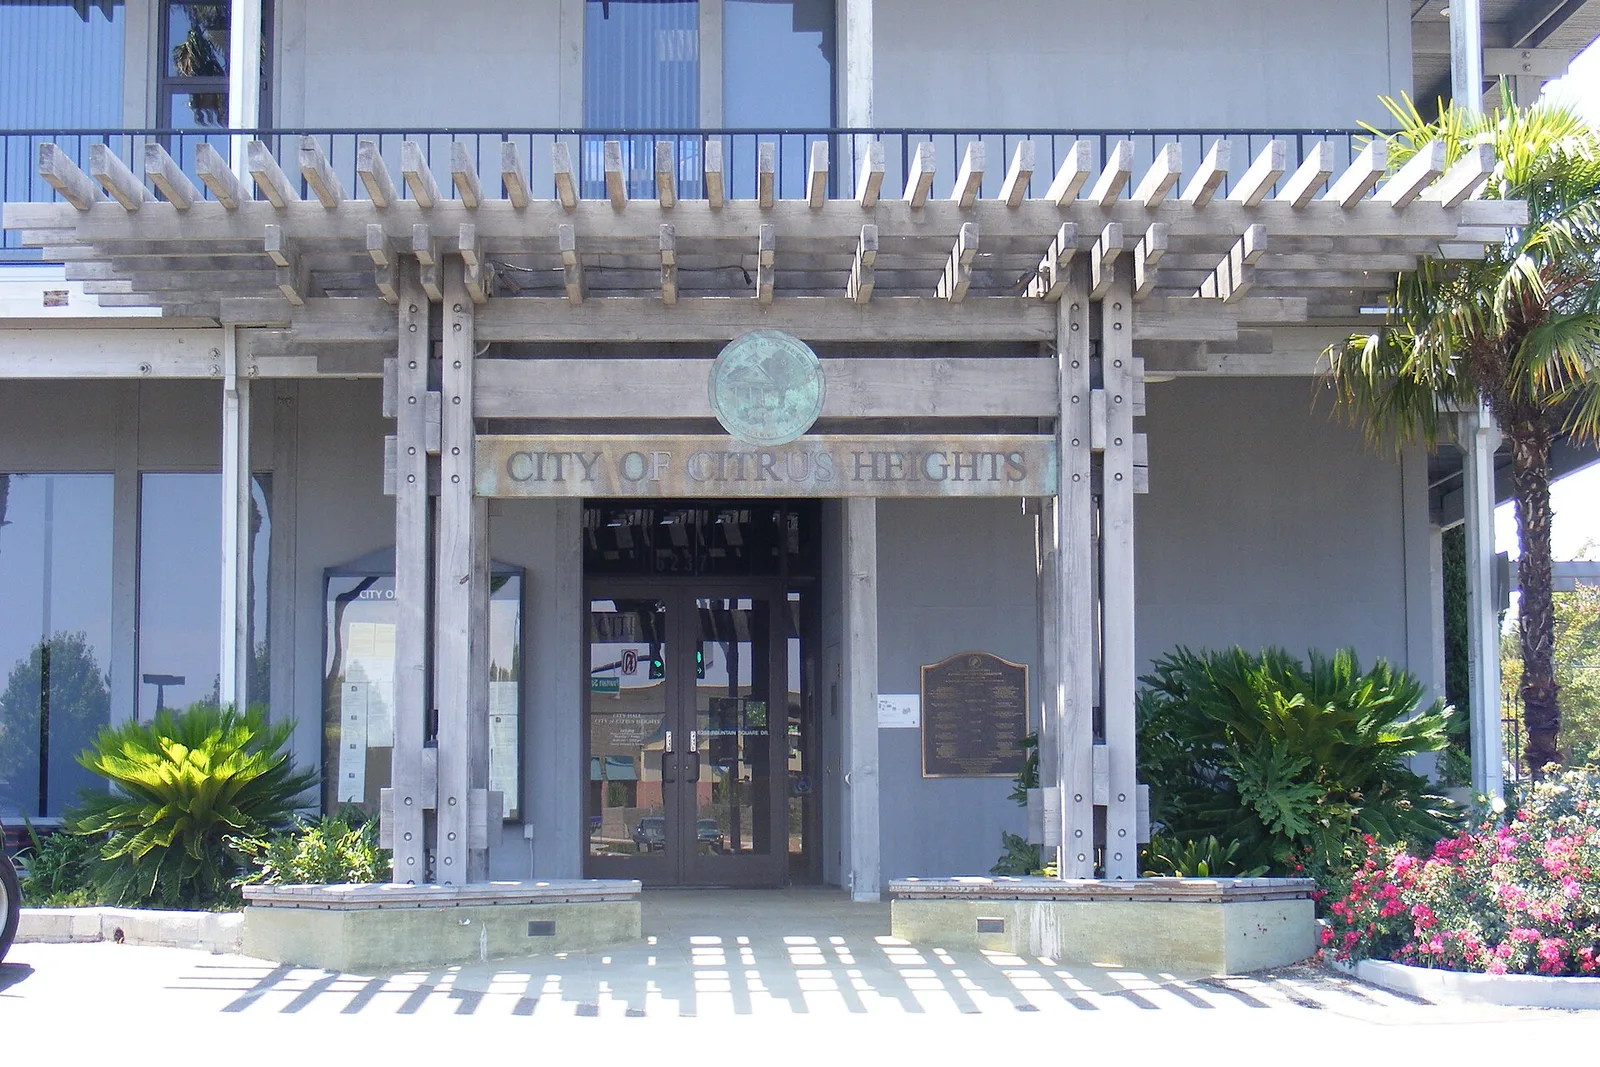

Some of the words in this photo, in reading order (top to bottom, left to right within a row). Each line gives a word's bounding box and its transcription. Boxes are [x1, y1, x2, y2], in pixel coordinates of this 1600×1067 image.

[506, 450, 602, 483] CITY
[618, 450, 673, 483] OF
[686, 450, 835, 484] CITRUS
[852, 450, 1027, 483] HEIGHTS
[359, 589, 382, 599] CITY
